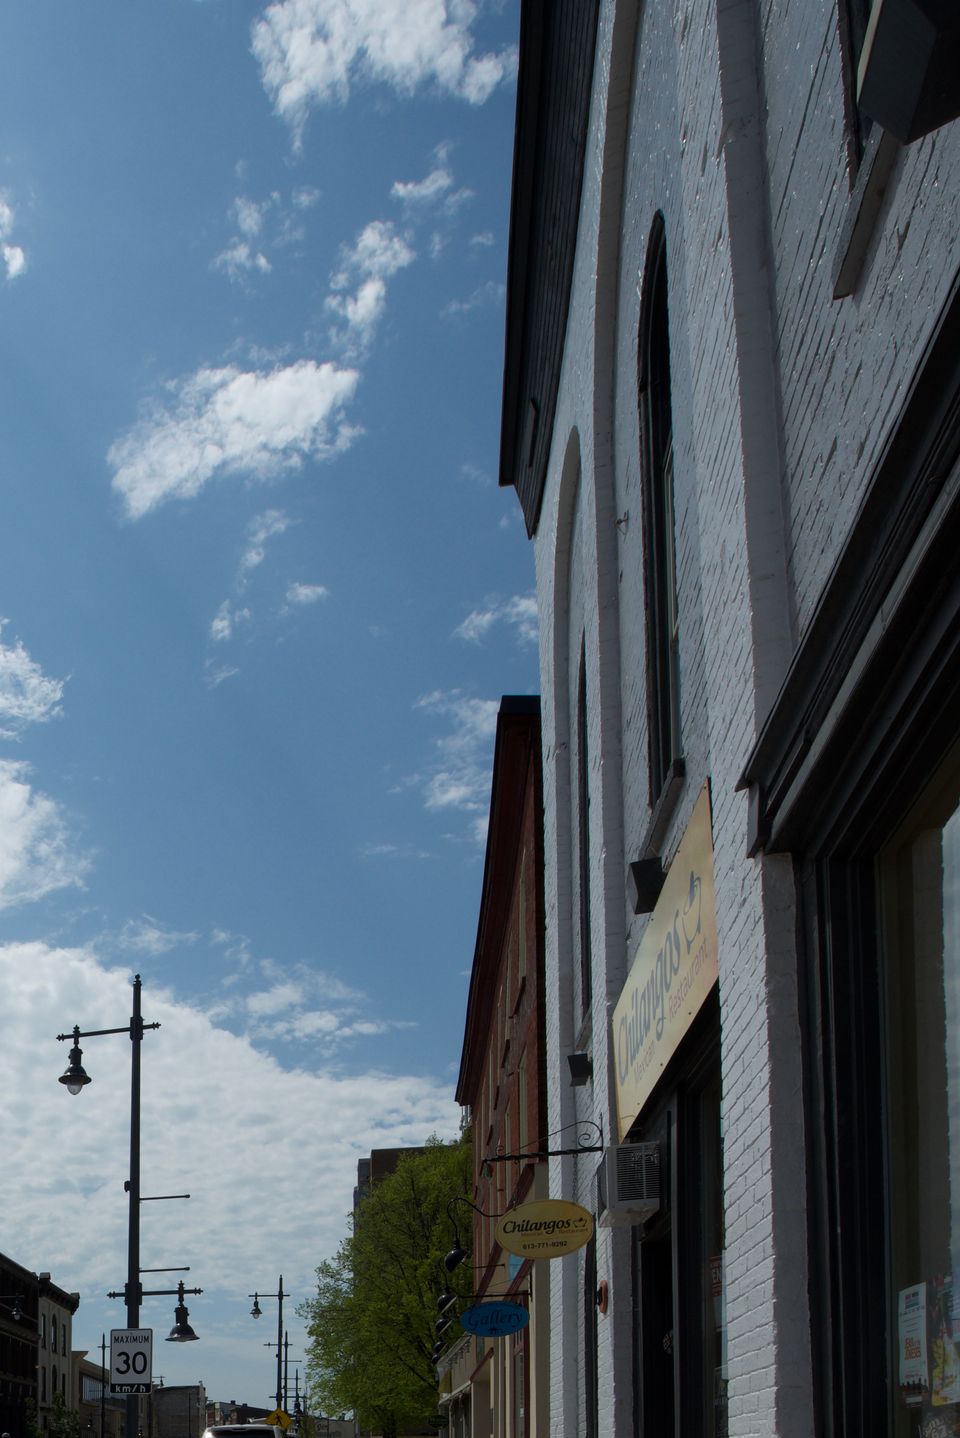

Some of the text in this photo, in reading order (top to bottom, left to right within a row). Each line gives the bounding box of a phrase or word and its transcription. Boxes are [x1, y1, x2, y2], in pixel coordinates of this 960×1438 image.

[668, 938, 710, 1023] Restaurant
[618, 911, 681, 1087] Chilangos
[502, 1218, 572, 1235] Chilangos
[467, 1310, 522, 1330] Gallery
[113, 1335, 150, 1344] MAXIMUM
[115, 1351, 148, 1375] 30
[115, 1384, 147, 1393] km/h
